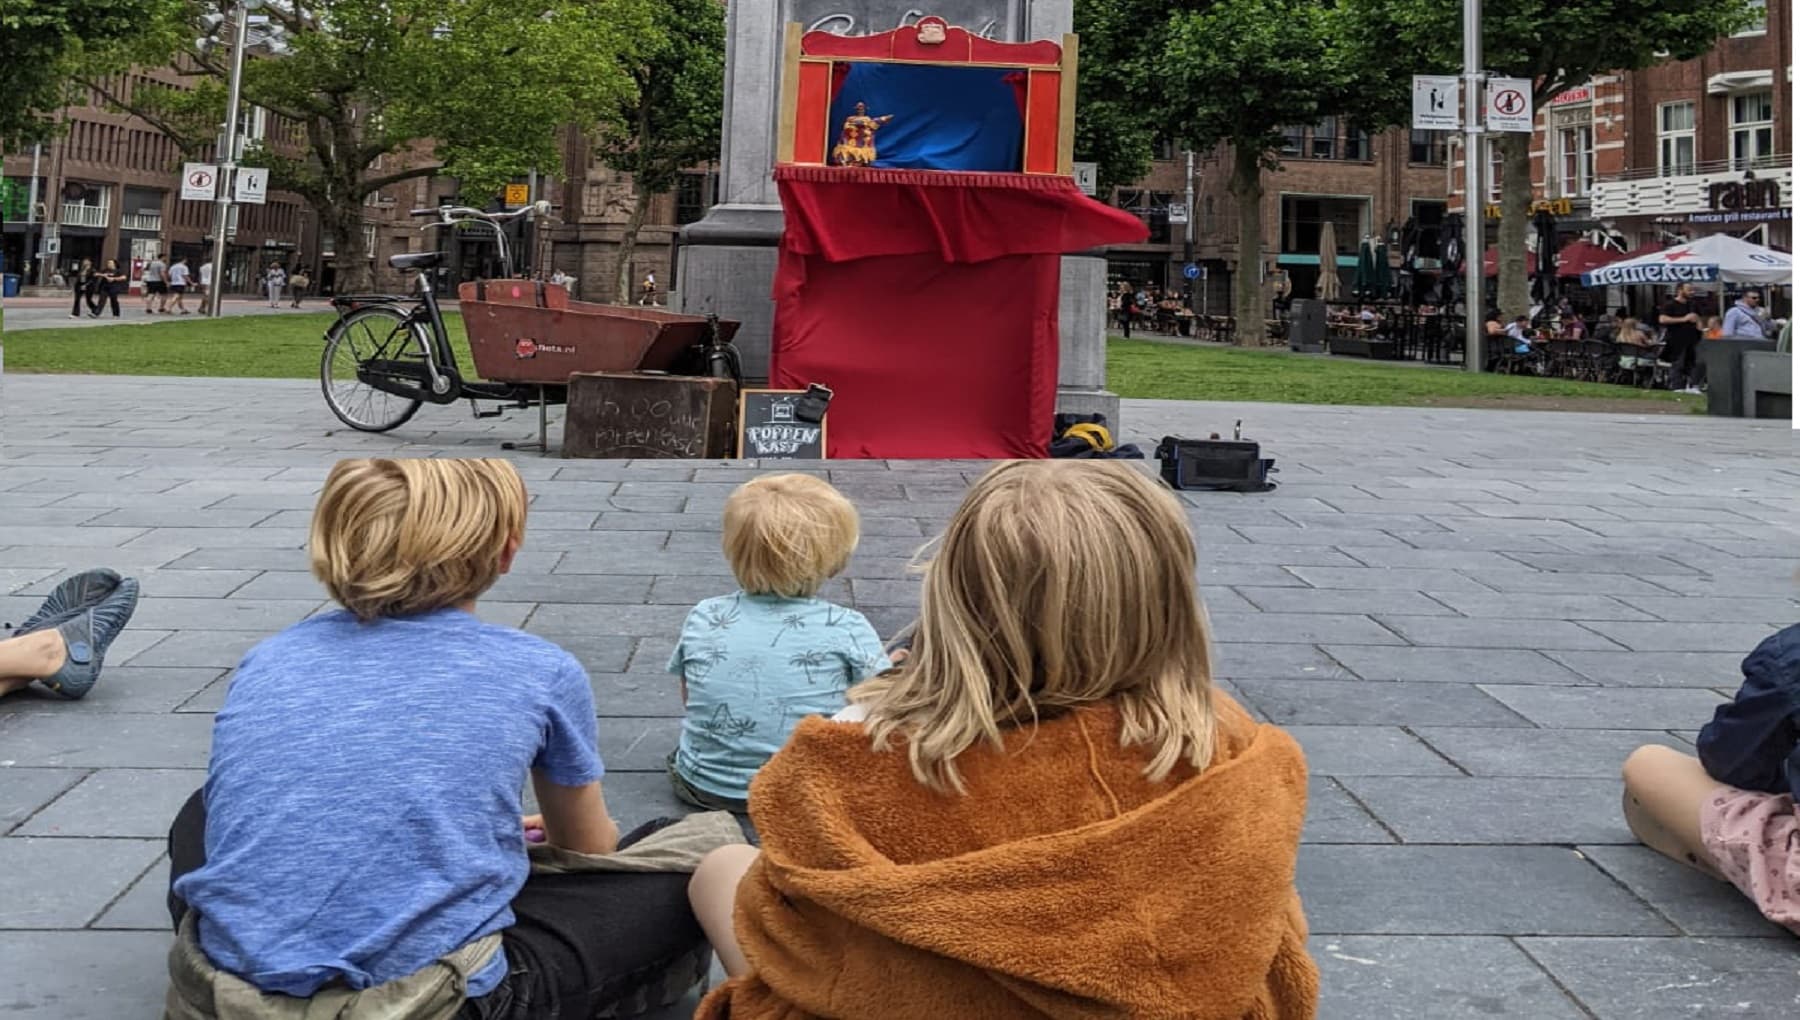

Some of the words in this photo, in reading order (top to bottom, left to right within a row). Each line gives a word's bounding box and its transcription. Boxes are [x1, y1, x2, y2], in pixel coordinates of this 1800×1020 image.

[1709, 169, 1780, 209] rain
[1688, 213, 1722, 222] American
[1724, 212, 1739, 223] grill
[1741, 211, 1780, 221] restaurant
[746, 425, 820, 444] POPPEN
[756, 441, 801, 455] KAST
